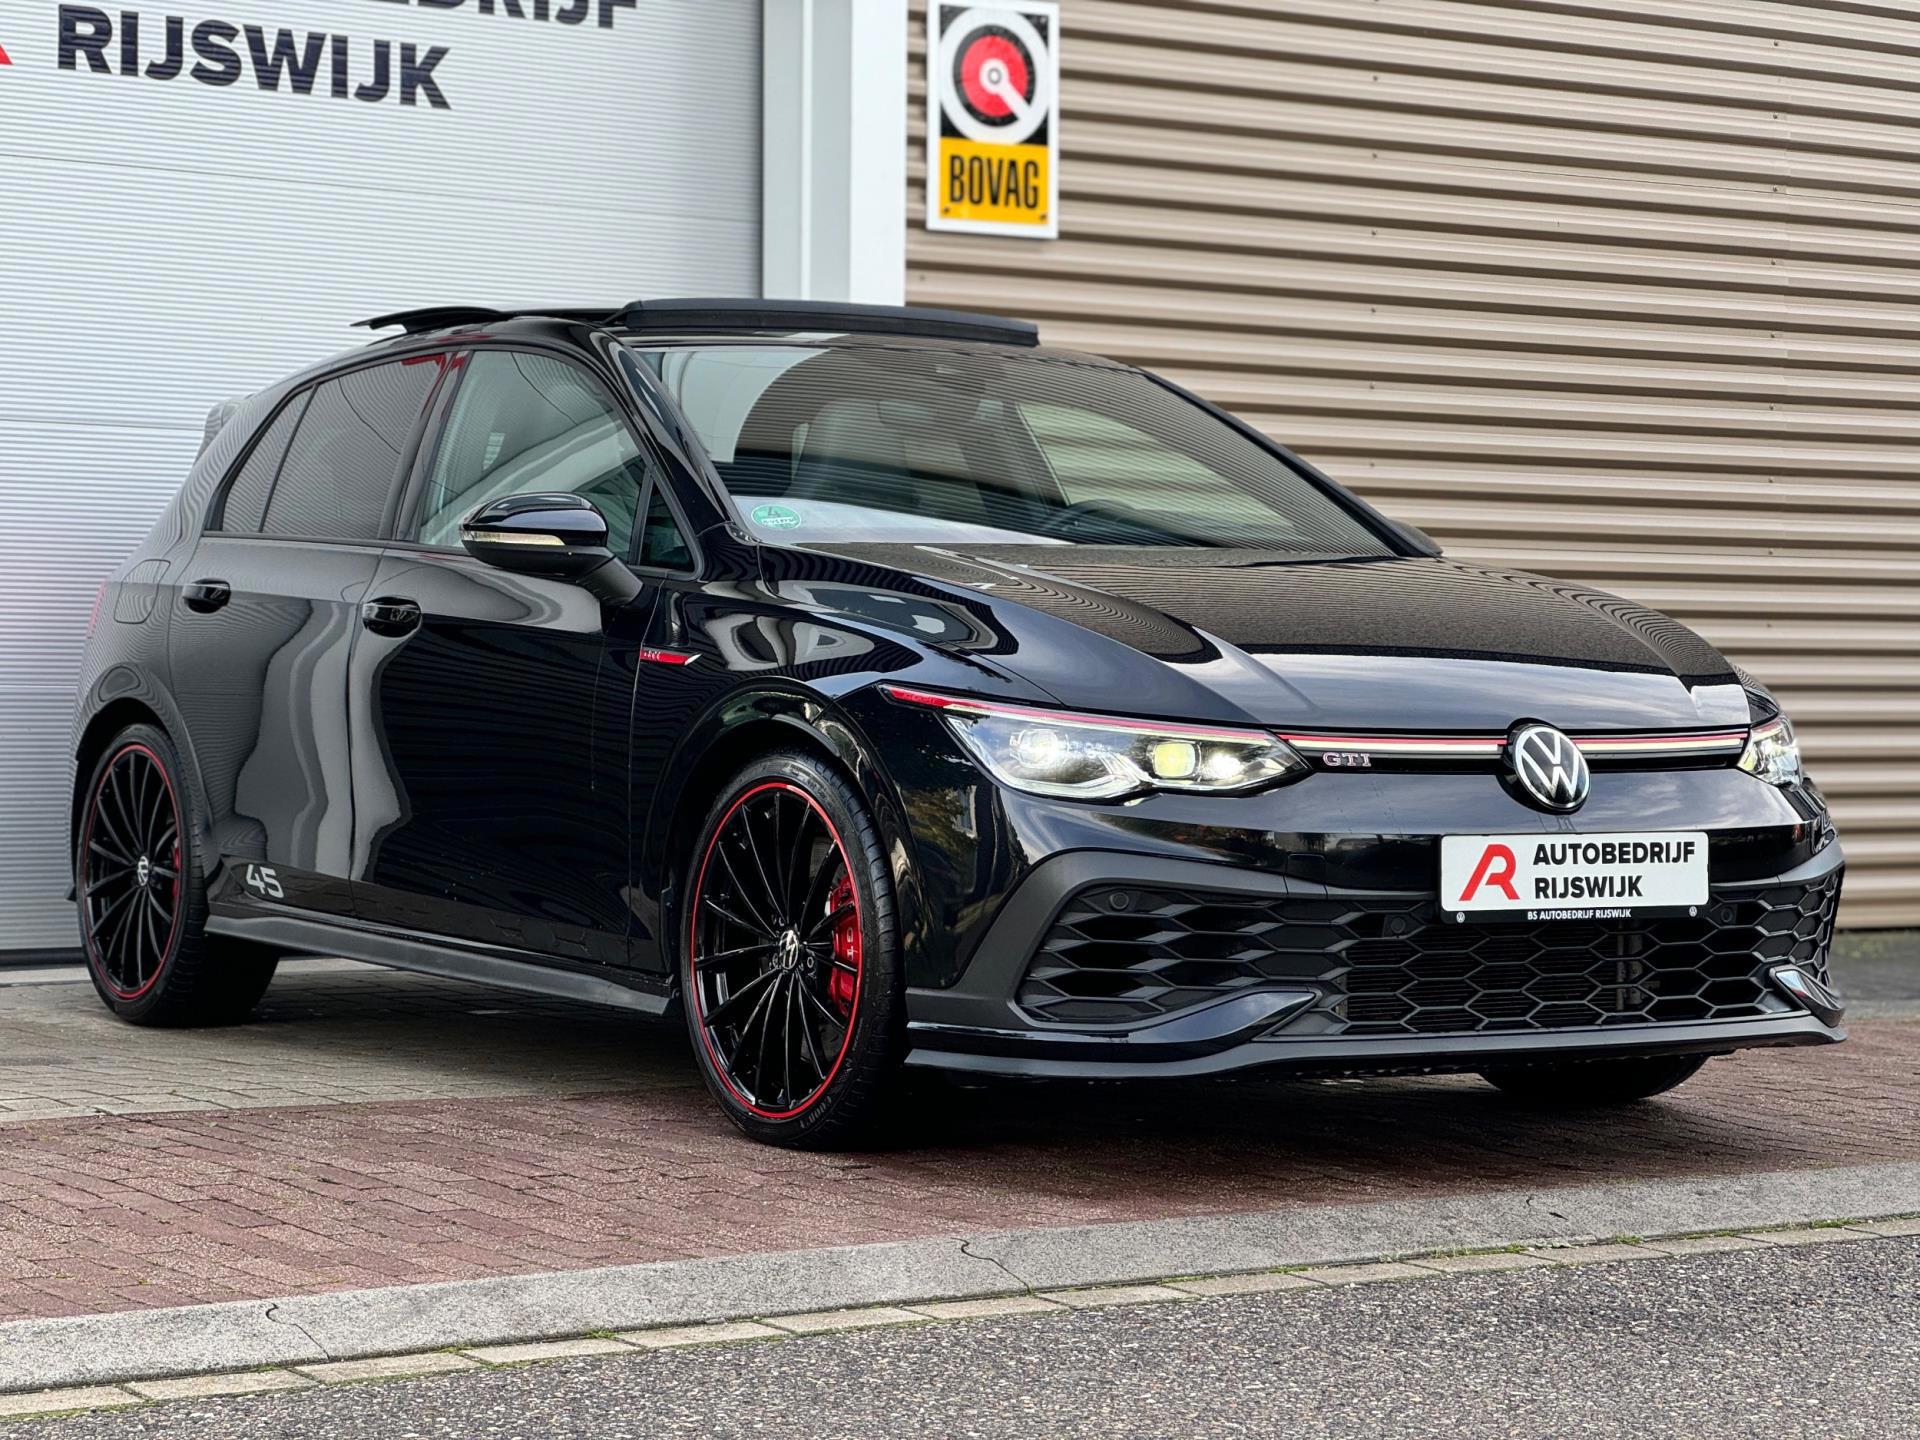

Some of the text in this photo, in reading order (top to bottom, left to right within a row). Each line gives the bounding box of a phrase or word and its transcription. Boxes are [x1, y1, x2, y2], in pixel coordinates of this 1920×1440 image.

[57, 4, 452, 110] RIJSWIJK
[949, 154, 1039, 209] BOVAG
[1322, 751, 1372, 767] GTI
[1533, 841, 1696, 865] AUTOBEDRIJF
[246, 864, 284, 898] 45
[1534, 875, 1643, 899] RIJSWIJK
[1527, 909, 1631, 920] BS AUTOBEDRIJF RIJSWIJK
